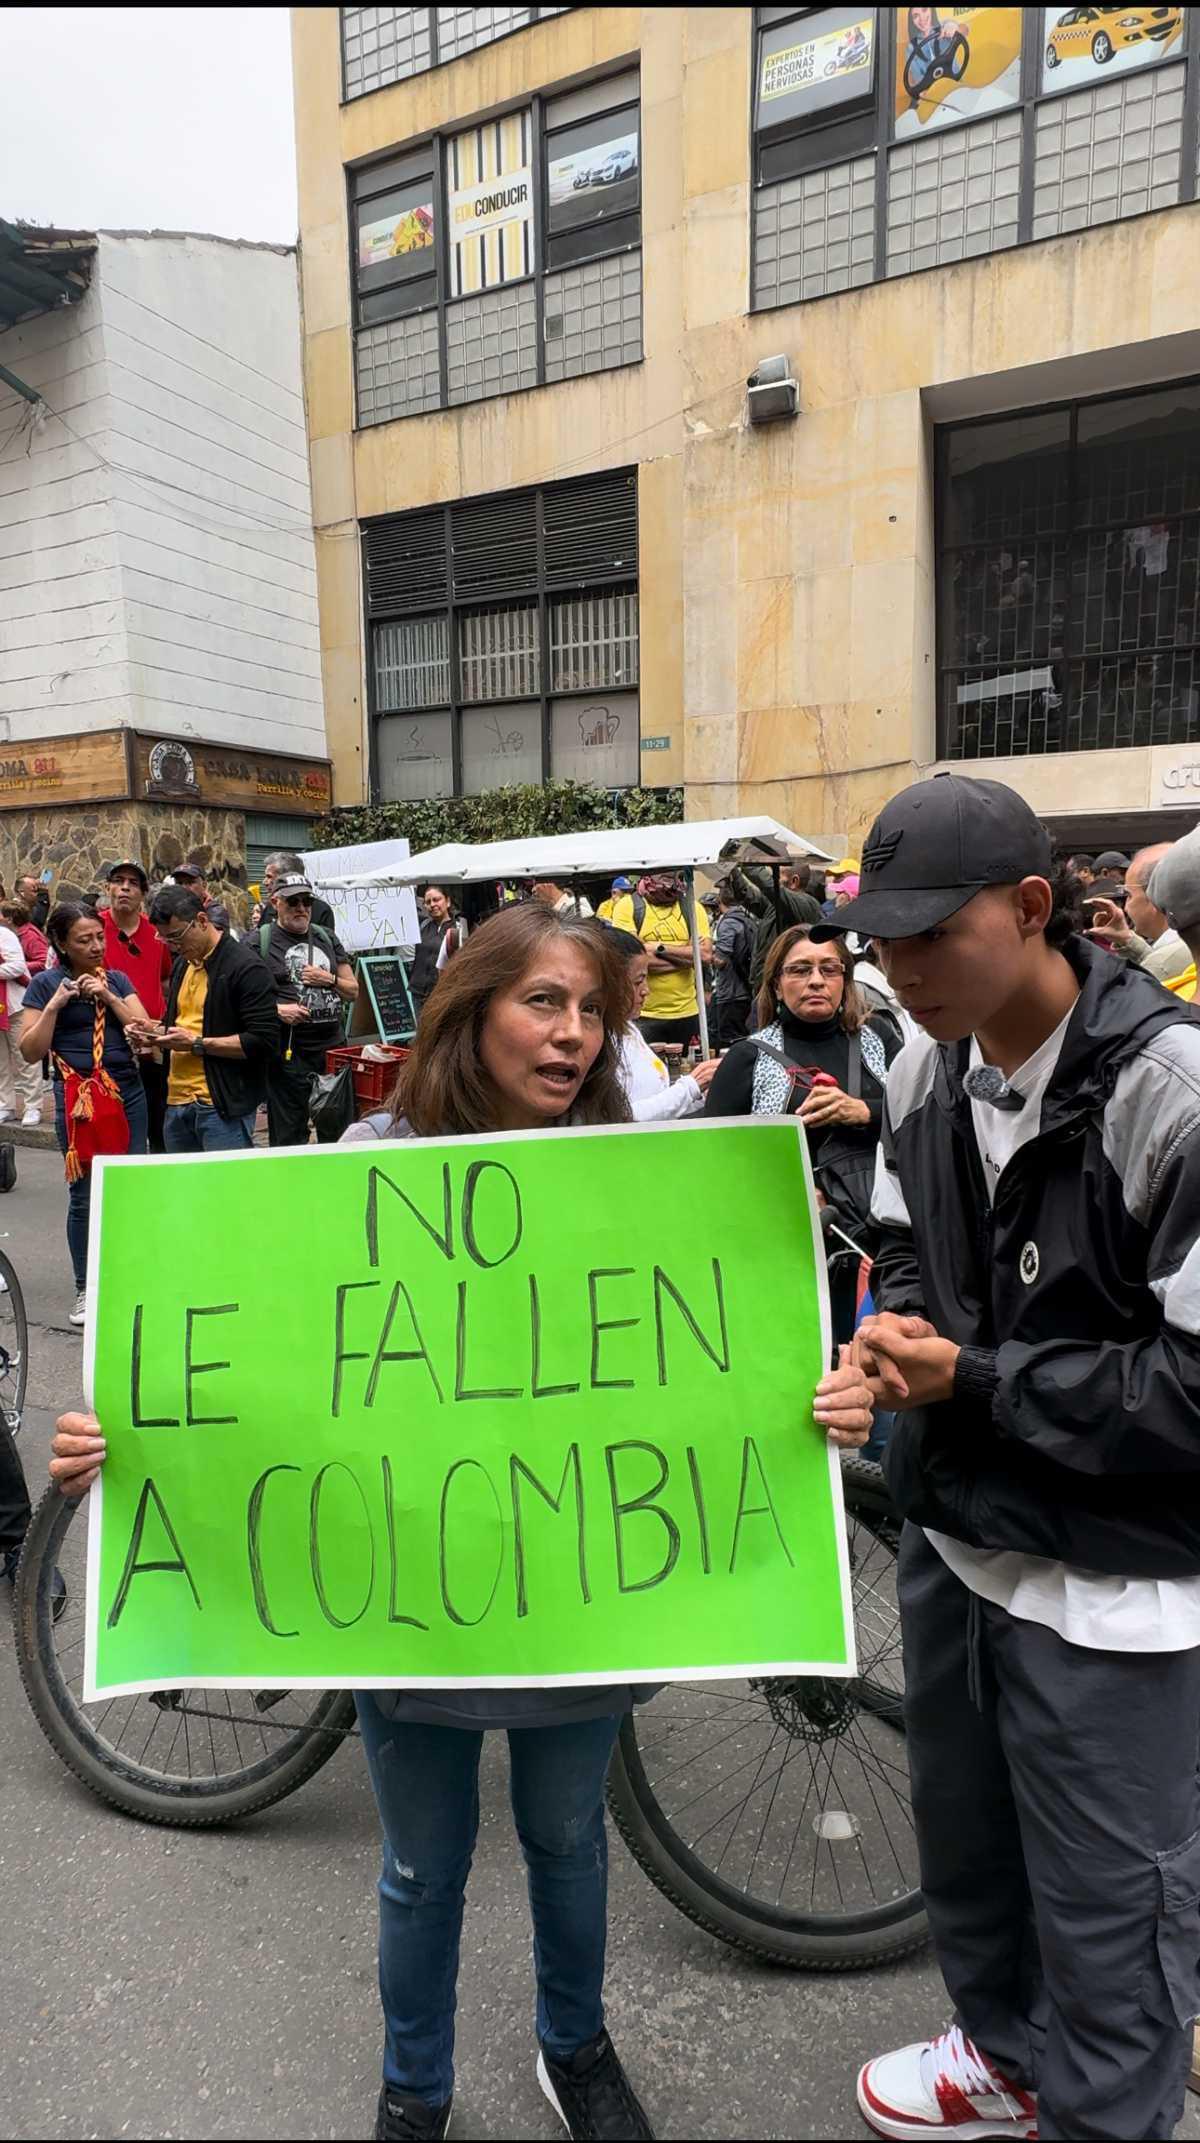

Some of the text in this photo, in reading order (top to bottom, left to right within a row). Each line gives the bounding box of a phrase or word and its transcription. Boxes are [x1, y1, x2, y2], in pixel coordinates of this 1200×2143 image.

[765, 55, 815, 80] PERSONAS
[766, 44, 815, 69] EXPERTOS EN
[764, 67, 814, 93] NERVIOSAS
[358, 902, 379, 923] DE
[371, 915, 406, 947] YA!
[368, 1160, 522, 1268] NO
[131, 1257, 729, 1428] LE FALLEN
[107, 1435, 795, 1637] A COLOMBIA
